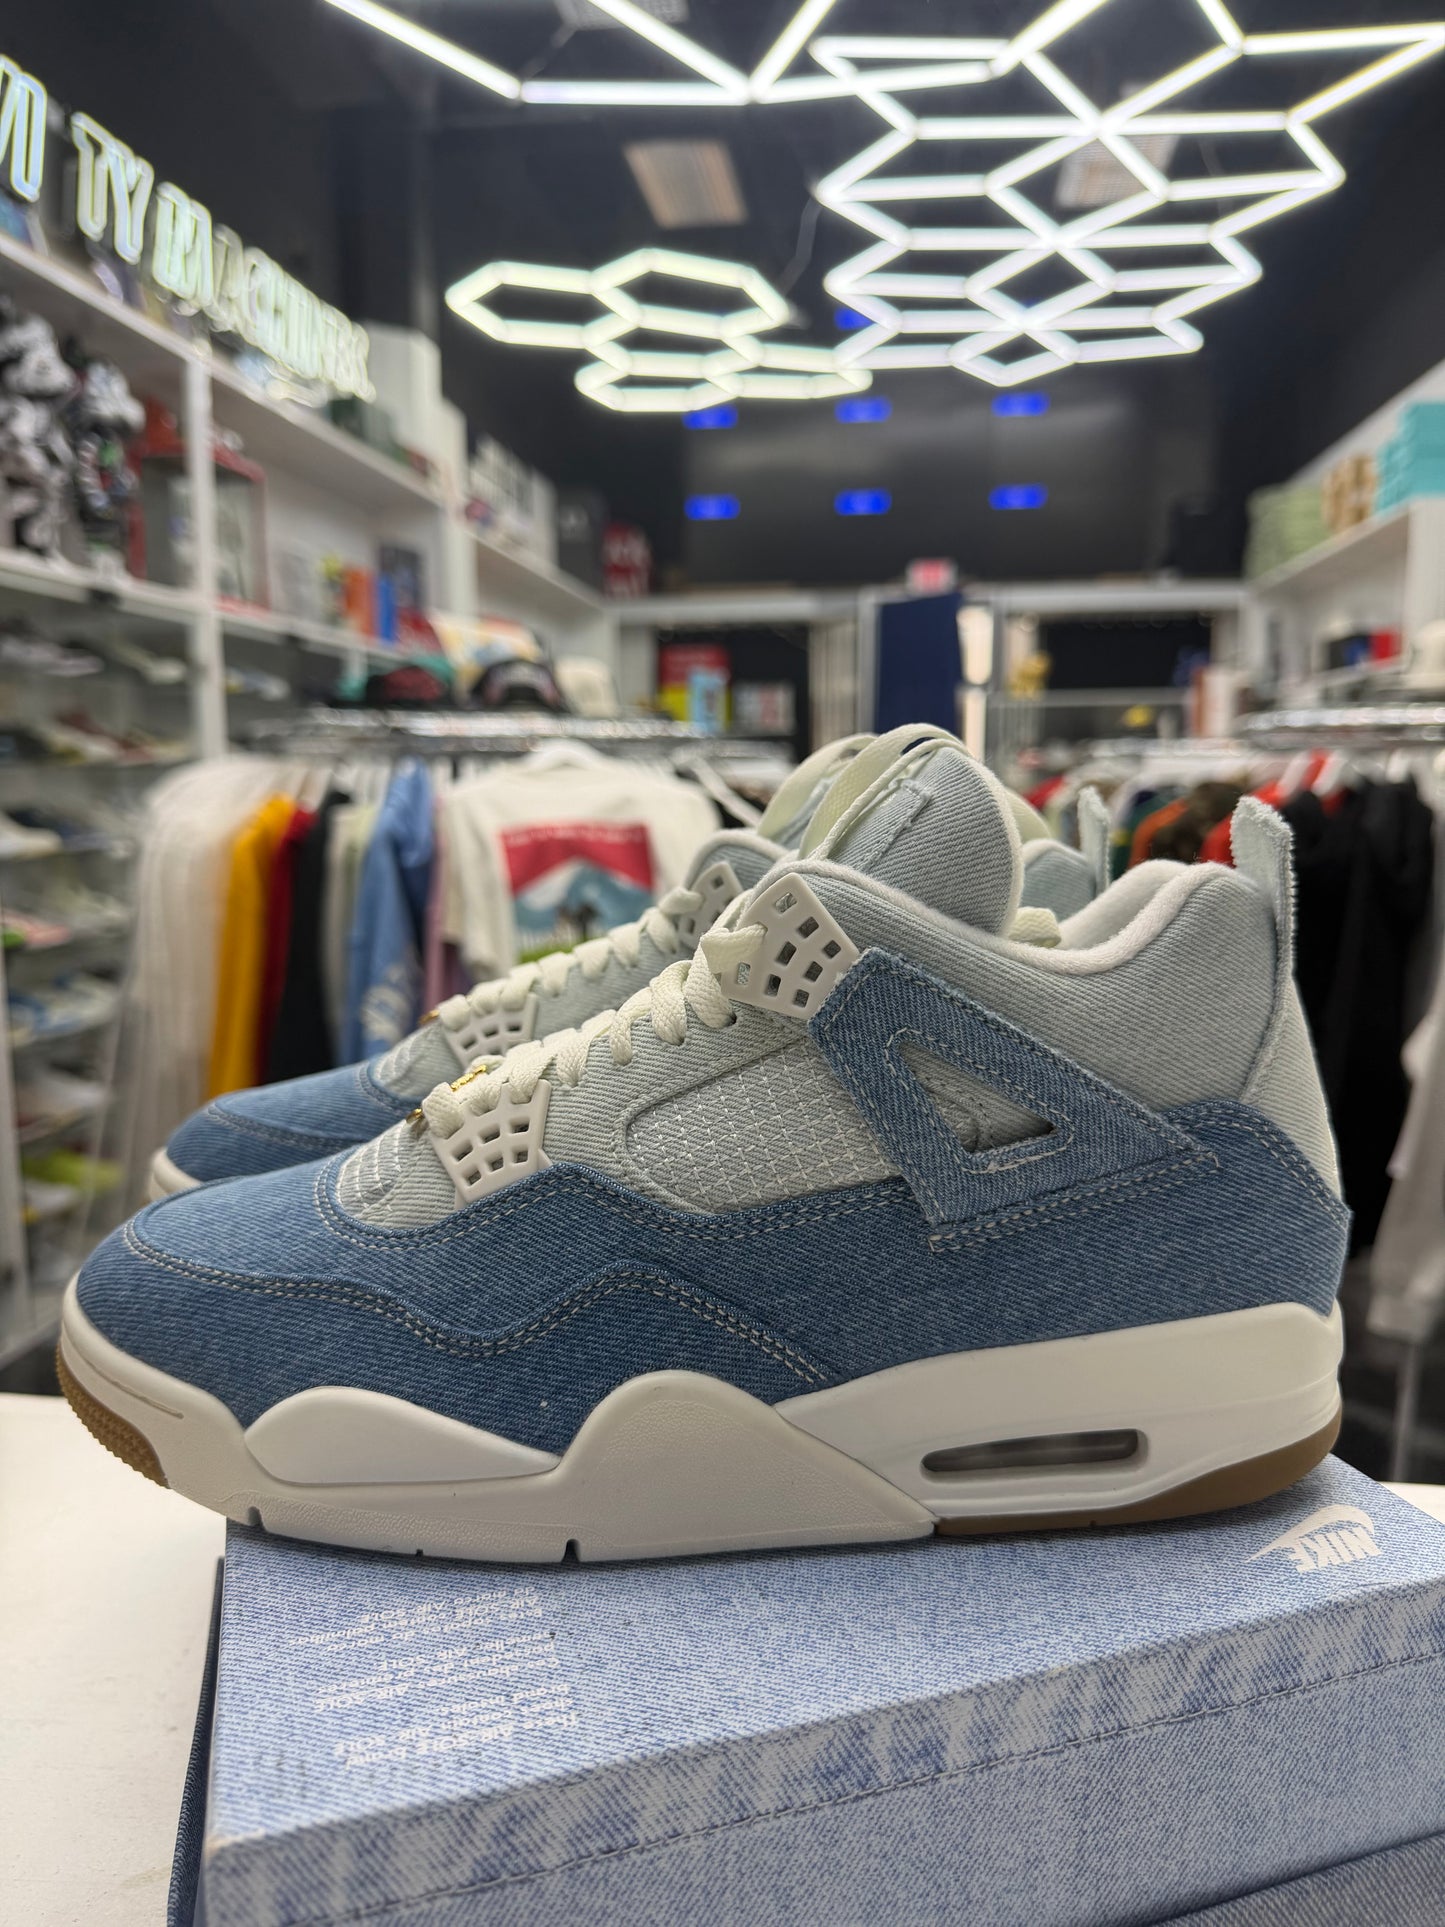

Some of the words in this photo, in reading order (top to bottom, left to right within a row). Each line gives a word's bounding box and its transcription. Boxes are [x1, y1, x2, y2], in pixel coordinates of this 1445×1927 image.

[1290, 1527, 1382, 1573] NIKE
[528, 1657, 558, 1668] Ces
[512, 1684, 569, 1704] brand
